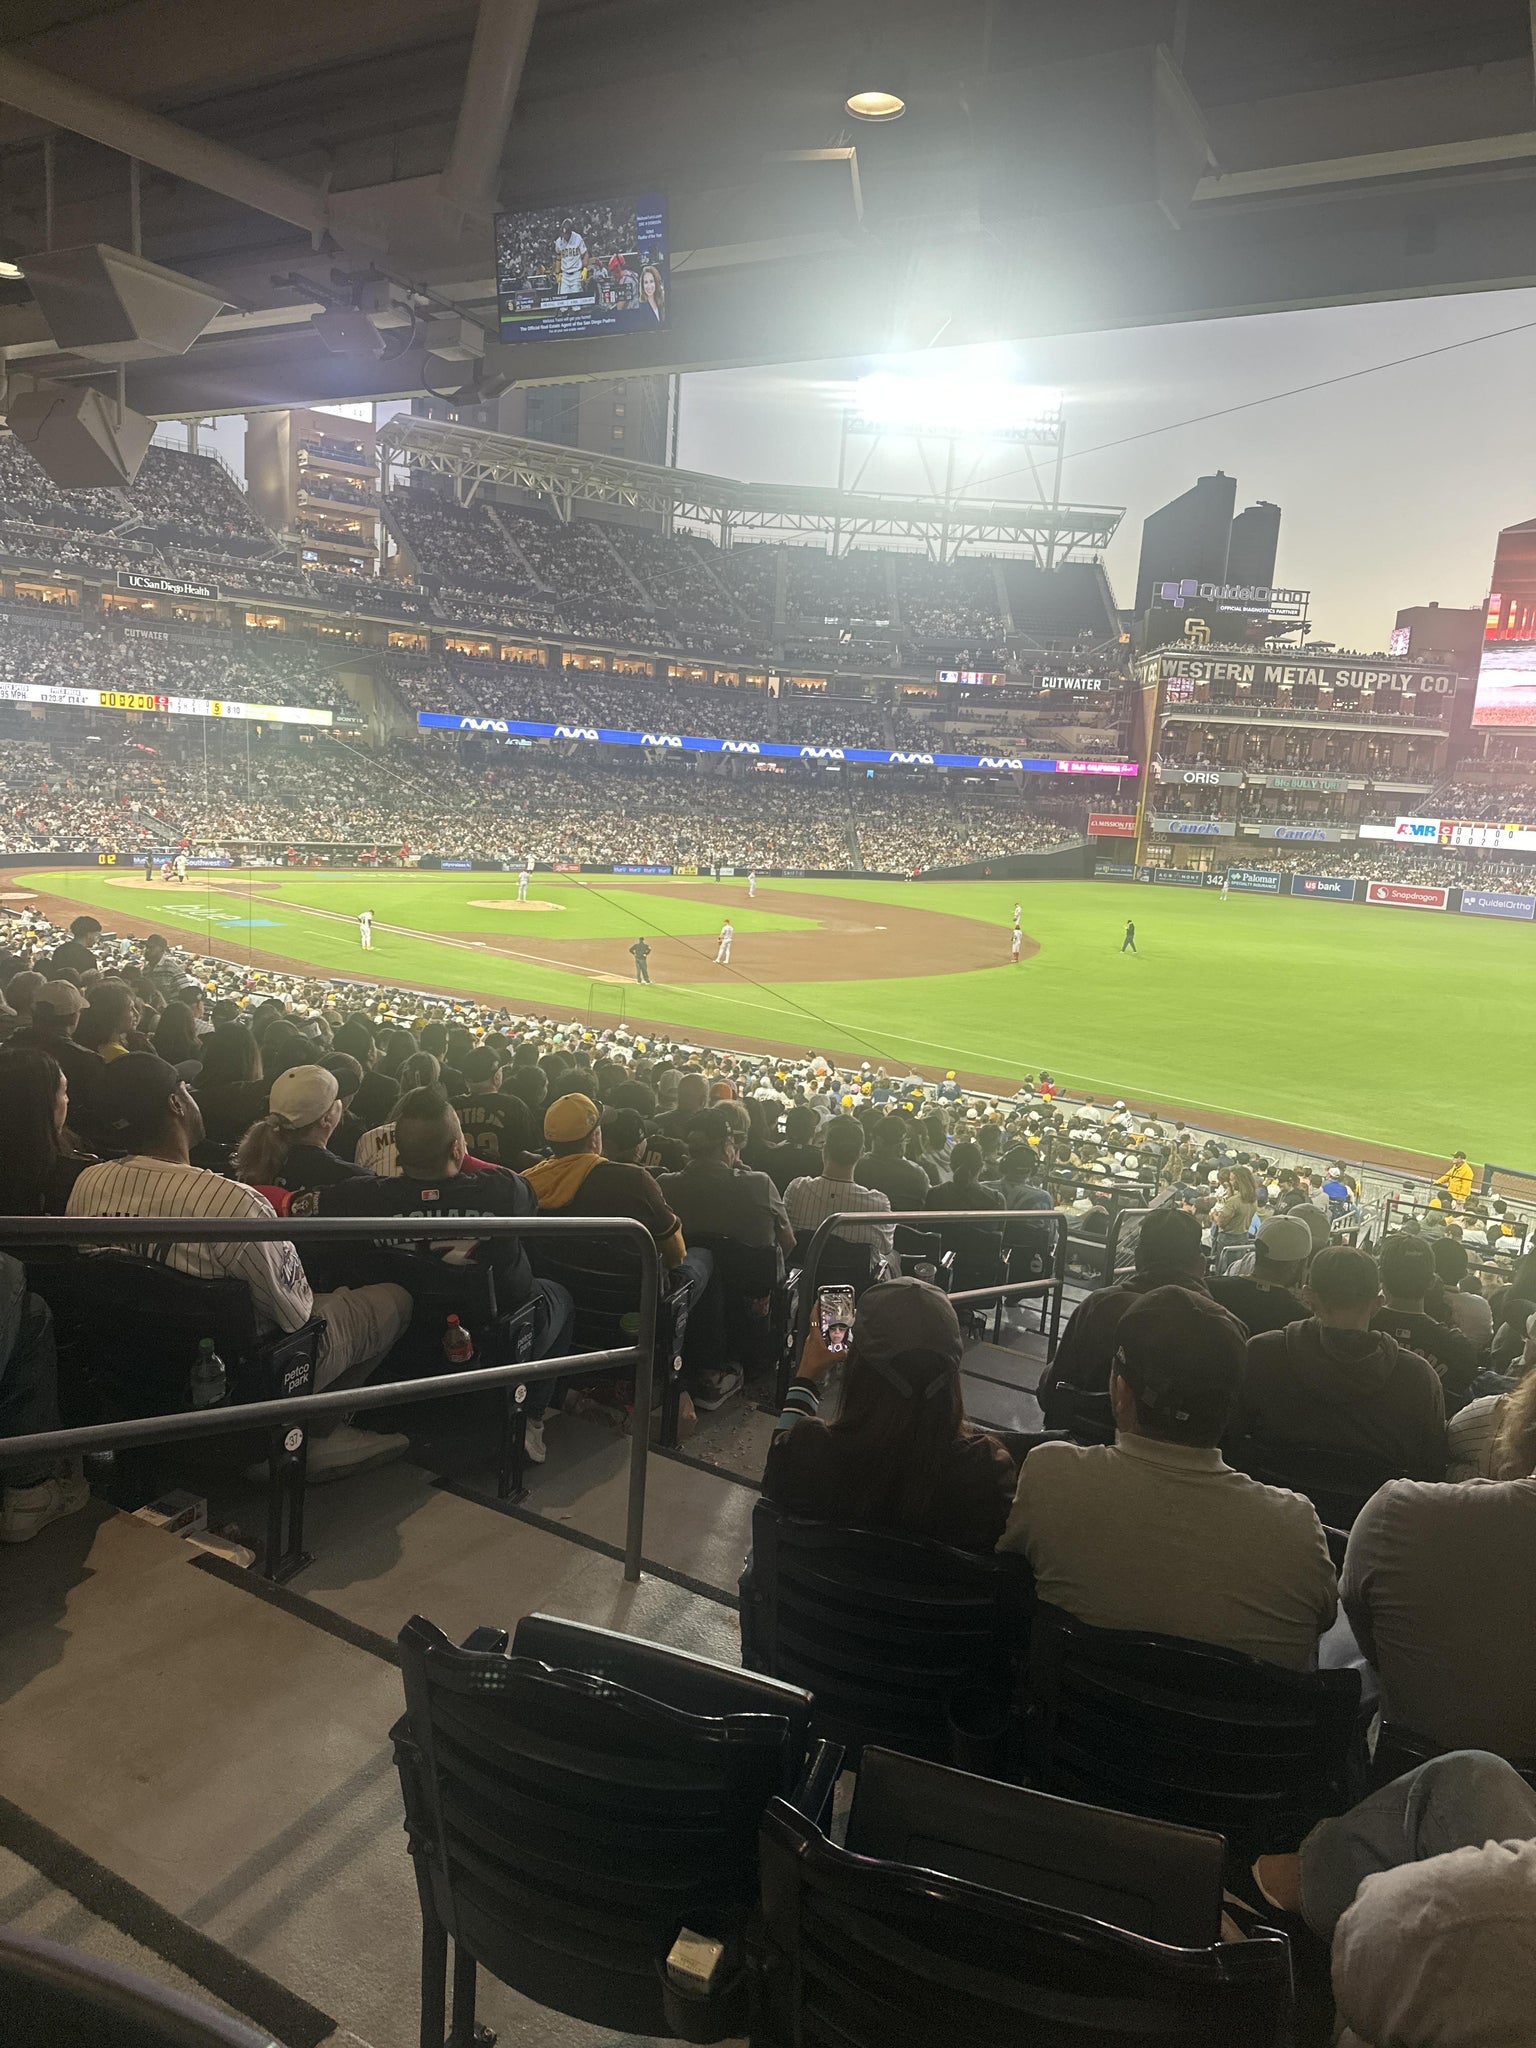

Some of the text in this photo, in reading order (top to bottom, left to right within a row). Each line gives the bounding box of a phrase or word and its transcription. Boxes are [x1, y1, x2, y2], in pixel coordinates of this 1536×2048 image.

[129, 576, 210, 596] UC San Diego Health
[1201, 583, 1302, 602] QuidelOrtho
[124, 628, 168, 640] CUTWATER
[1042, 677, 1101, 690] CUTWATER
[1162, 660, 1454, 694] WESTERN METAL SUPPLY CO.
[11, 691, 26, 700] MPH
[110, 694, 116, 706] 0
[128, 695, 135, 708] 2
[147, 696, 154, 709] 0
[215, 703, 220, 712] 5
[460, 718, 508, 732] nuna
[554, 726, 598, 740] nuna
[641, 734, 682, 748] nuna
[722, 741, 760, 754] nuna
[800, 746, 844, 760] nuna
[890, 752, 934, 764] nuna
[978, 758, 1023, 770] nuna
[1184, 772, 1220, 784] ORIS
[1274, 778, 1290, 787] BIG
[1291, 780, 1317, 789] BULLY
[1169, 821, 1220, 834] Canel's
[1275, 827, 1326, 841] Canel's
[1151, 832, 1168, 842] 336
[186, 858, 221, 866] Southwest
[1207, 875, 1224, 885] 342
[1242, 873, 1278, 884] Palomar
[1304, 881, 1341, 892] us bank
[1392, 890, 1438, 902] Snapdragon
[1478, 898, 1531, 911] QuidelOrtho
[284, 1364, 310, 1386] petco
[288, 1372, 308, 1393] park
[289, 1433, 298, 1447] 37
